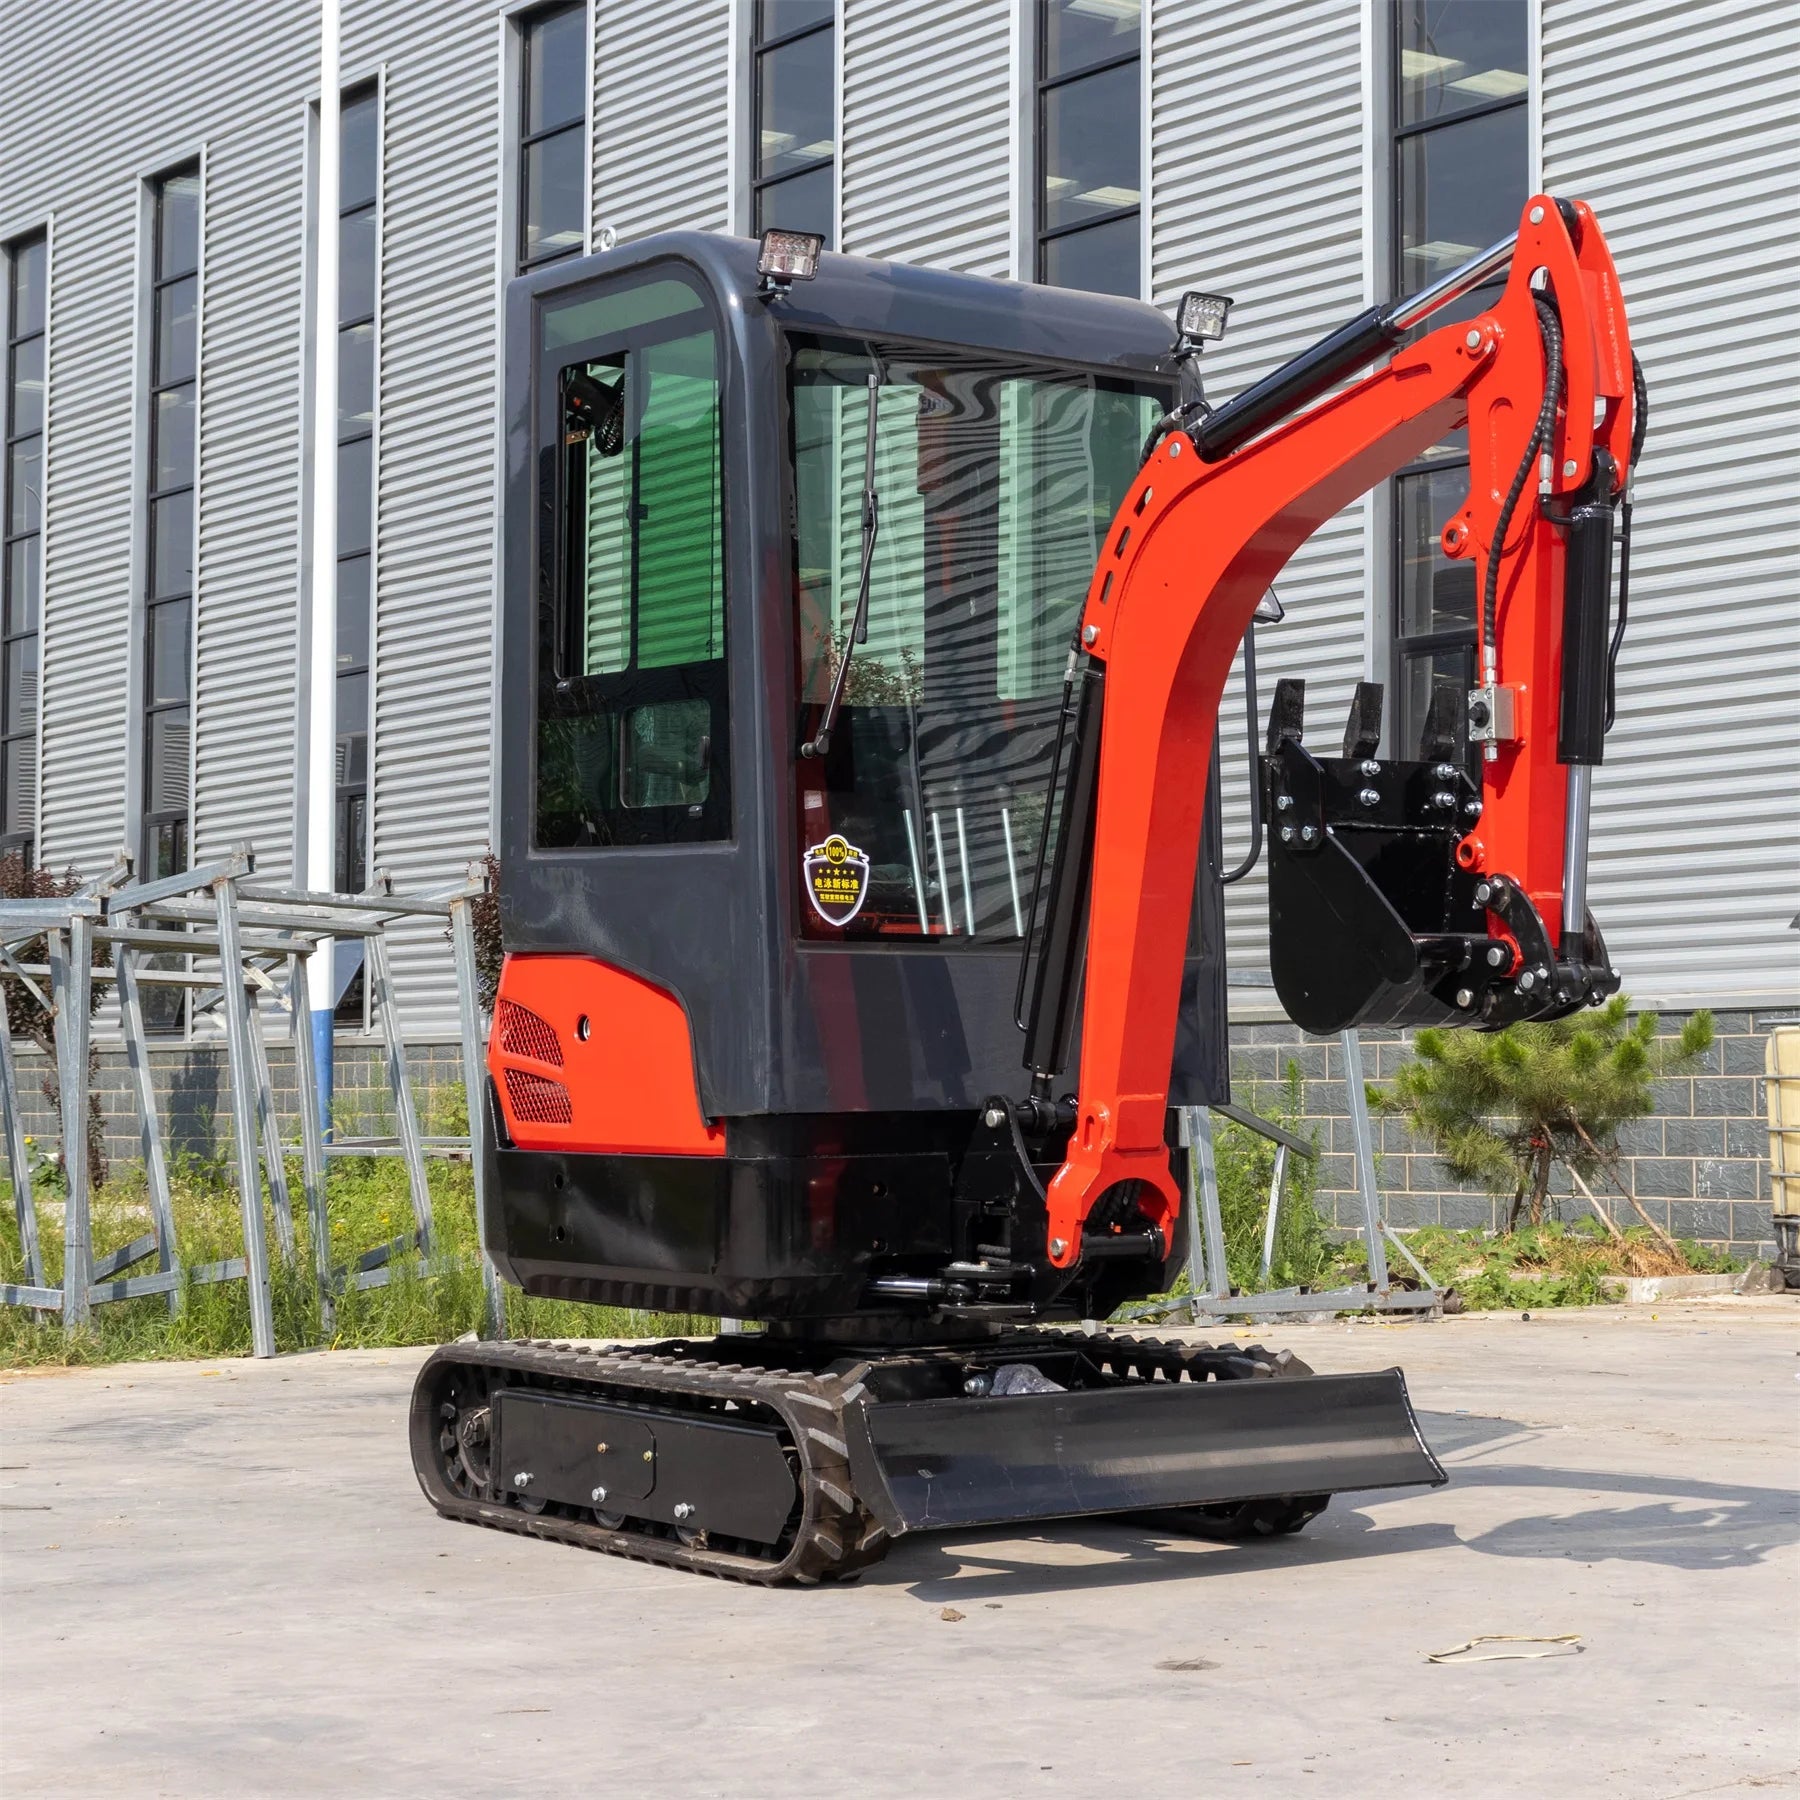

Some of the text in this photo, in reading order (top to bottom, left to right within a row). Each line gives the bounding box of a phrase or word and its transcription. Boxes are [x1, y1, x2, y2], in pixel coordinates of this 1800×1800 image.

[829, 846, 844, 857] 100%
[814, 877, 859, 890] 电泳新标准
